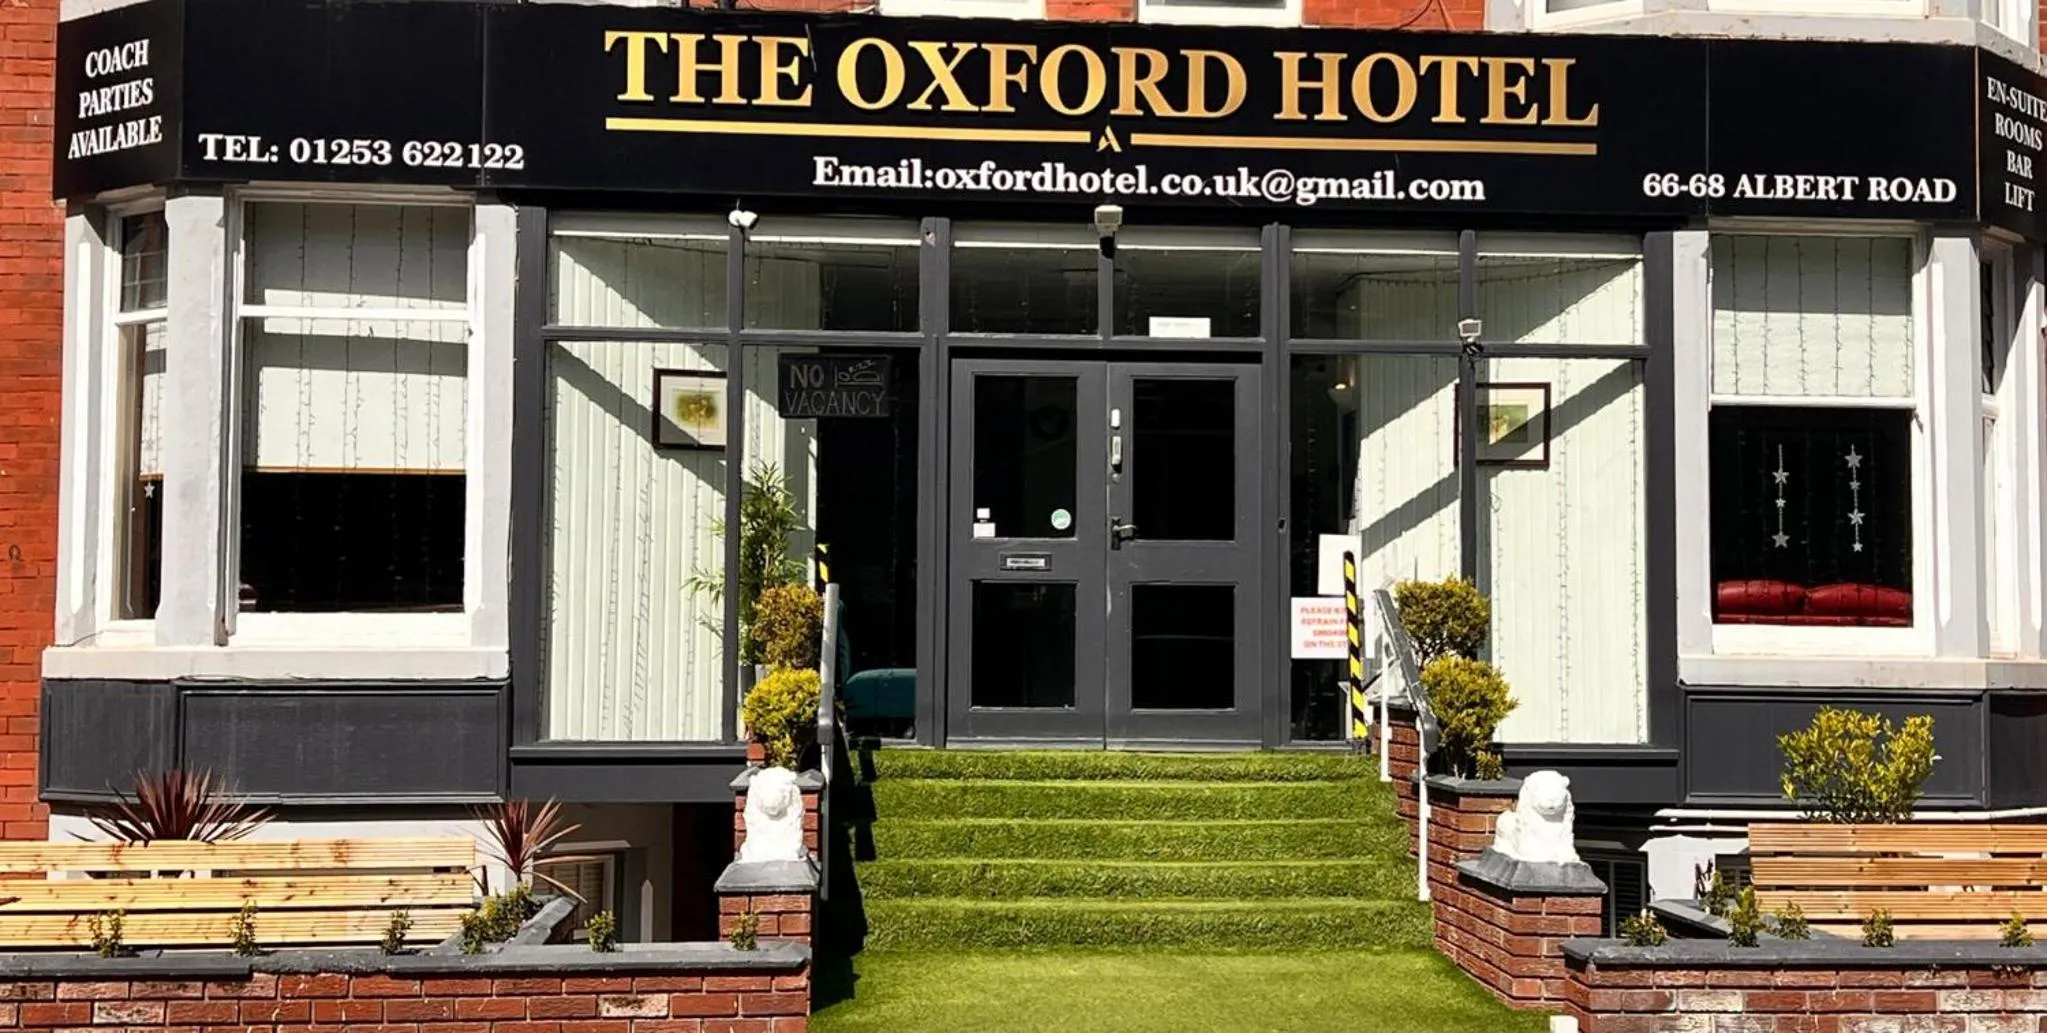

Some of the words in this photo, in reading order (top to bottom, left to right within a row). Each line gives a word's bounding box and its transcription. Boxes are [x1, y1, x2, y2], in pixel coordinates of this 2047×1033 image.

[84, 38, 150, 79] COACH
[604, 30, 813, 107] THE
[836, 36, 1248, 119] OXFORD
[1272, 51, 1600, 127] HOTEL
[77, 77, 154, 120] PARTIES
[1986, 75, 2047, 124] EN-SUITE
[67, 115, 163, 160] AVAILABLE
[1994, 111, 2044, 152] ROOMS
[198, 133, 279, 163] TEL:
[289, 137, 393, 166] 01253
[402, 140, 525, 170] 622122
[2006, 148, 2034, 180] BAR
[1643, 172, 1726, 200] 66-68
[1733, 173, 1859, 202] ALBERT
[1867, 176, 1957, 204] ROAD
[2004, 181, 2036, 213] LIFT
[789, 363, 825, 389] NO
[784, 390, 886, 416] VACANCY
